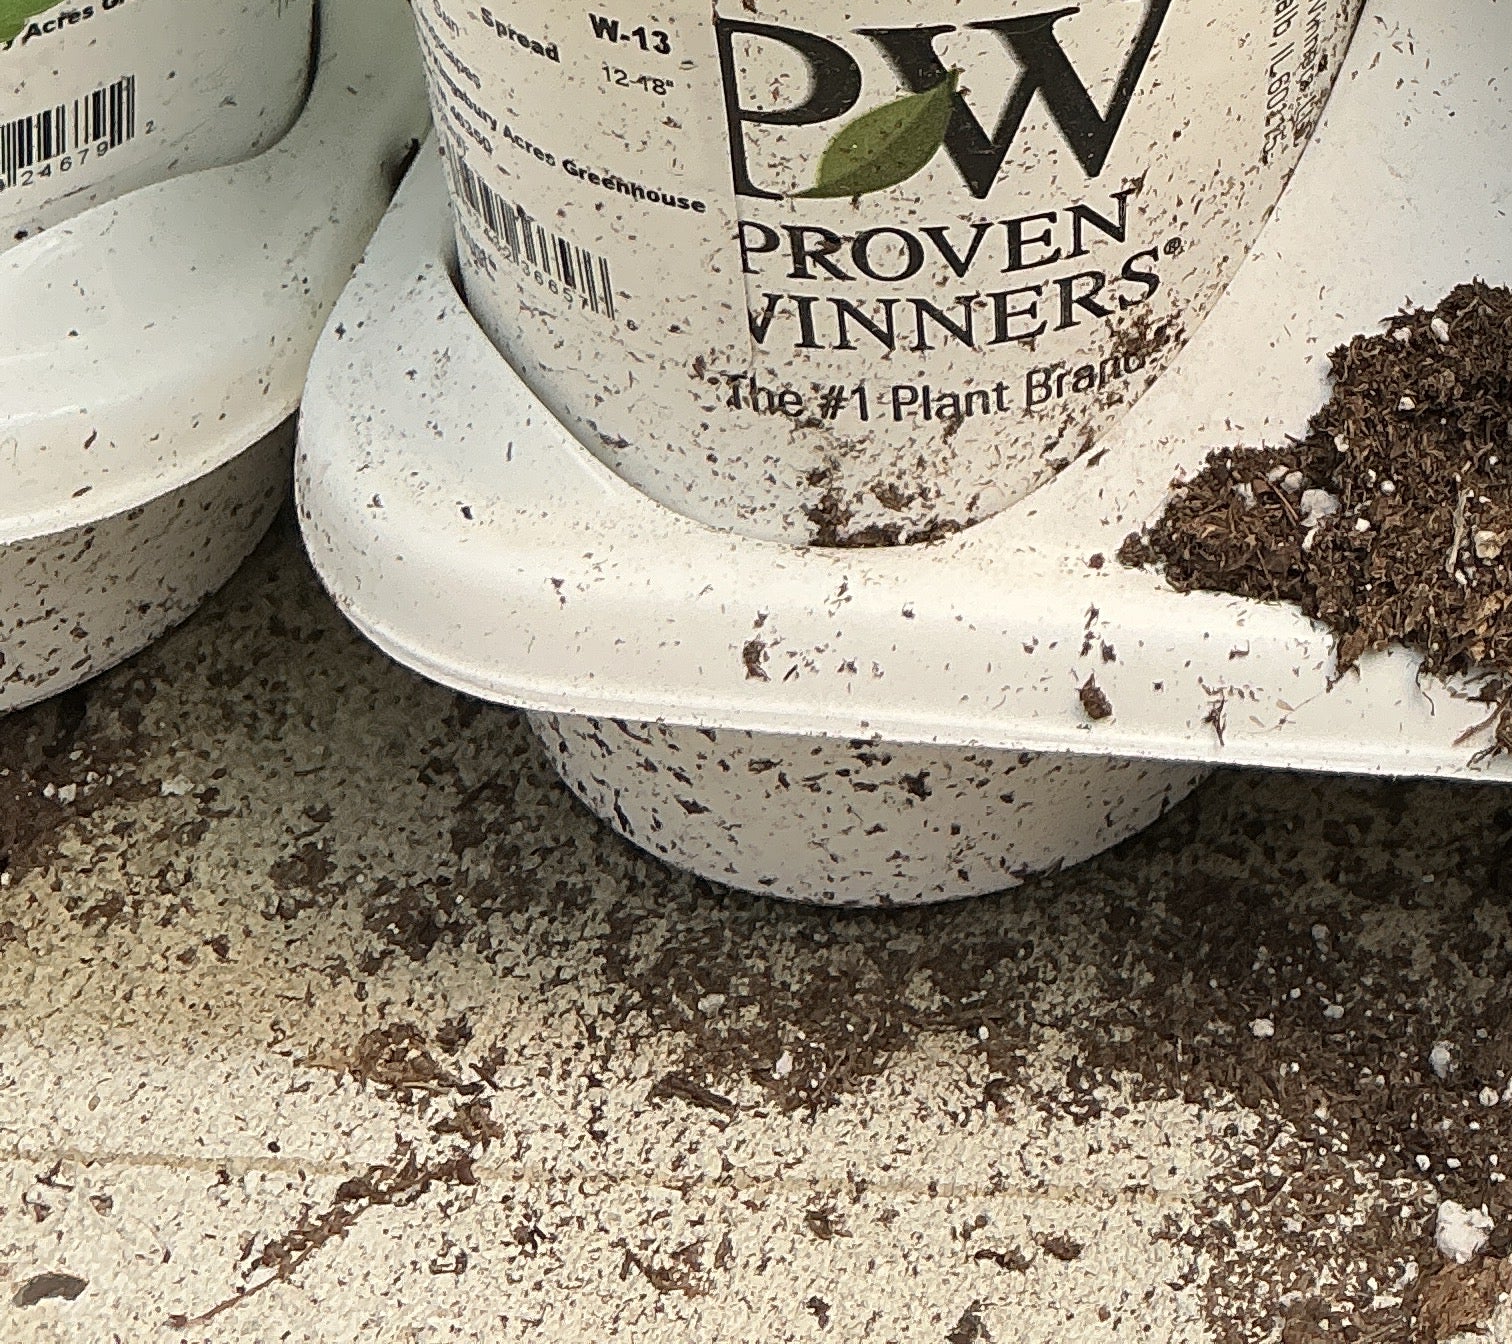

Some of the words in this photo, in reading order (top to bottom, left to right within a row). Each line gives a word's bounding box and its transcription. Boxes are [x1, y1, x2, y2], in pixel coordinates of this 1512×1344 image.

[22, 5, 95, 46] Acres
[480, 6, 560, 63] Spread
[588, 12, 672, 55] W-13
[503, 124, 557, 167] Acres
[562, 158, 707, 214] Greenhouse
[738, 189, 1135, 281] PROVEN
[722, 372, 802, 417] The
[818, 383, 870, 422] #1
[891, 382, 1009, 421] Plant
